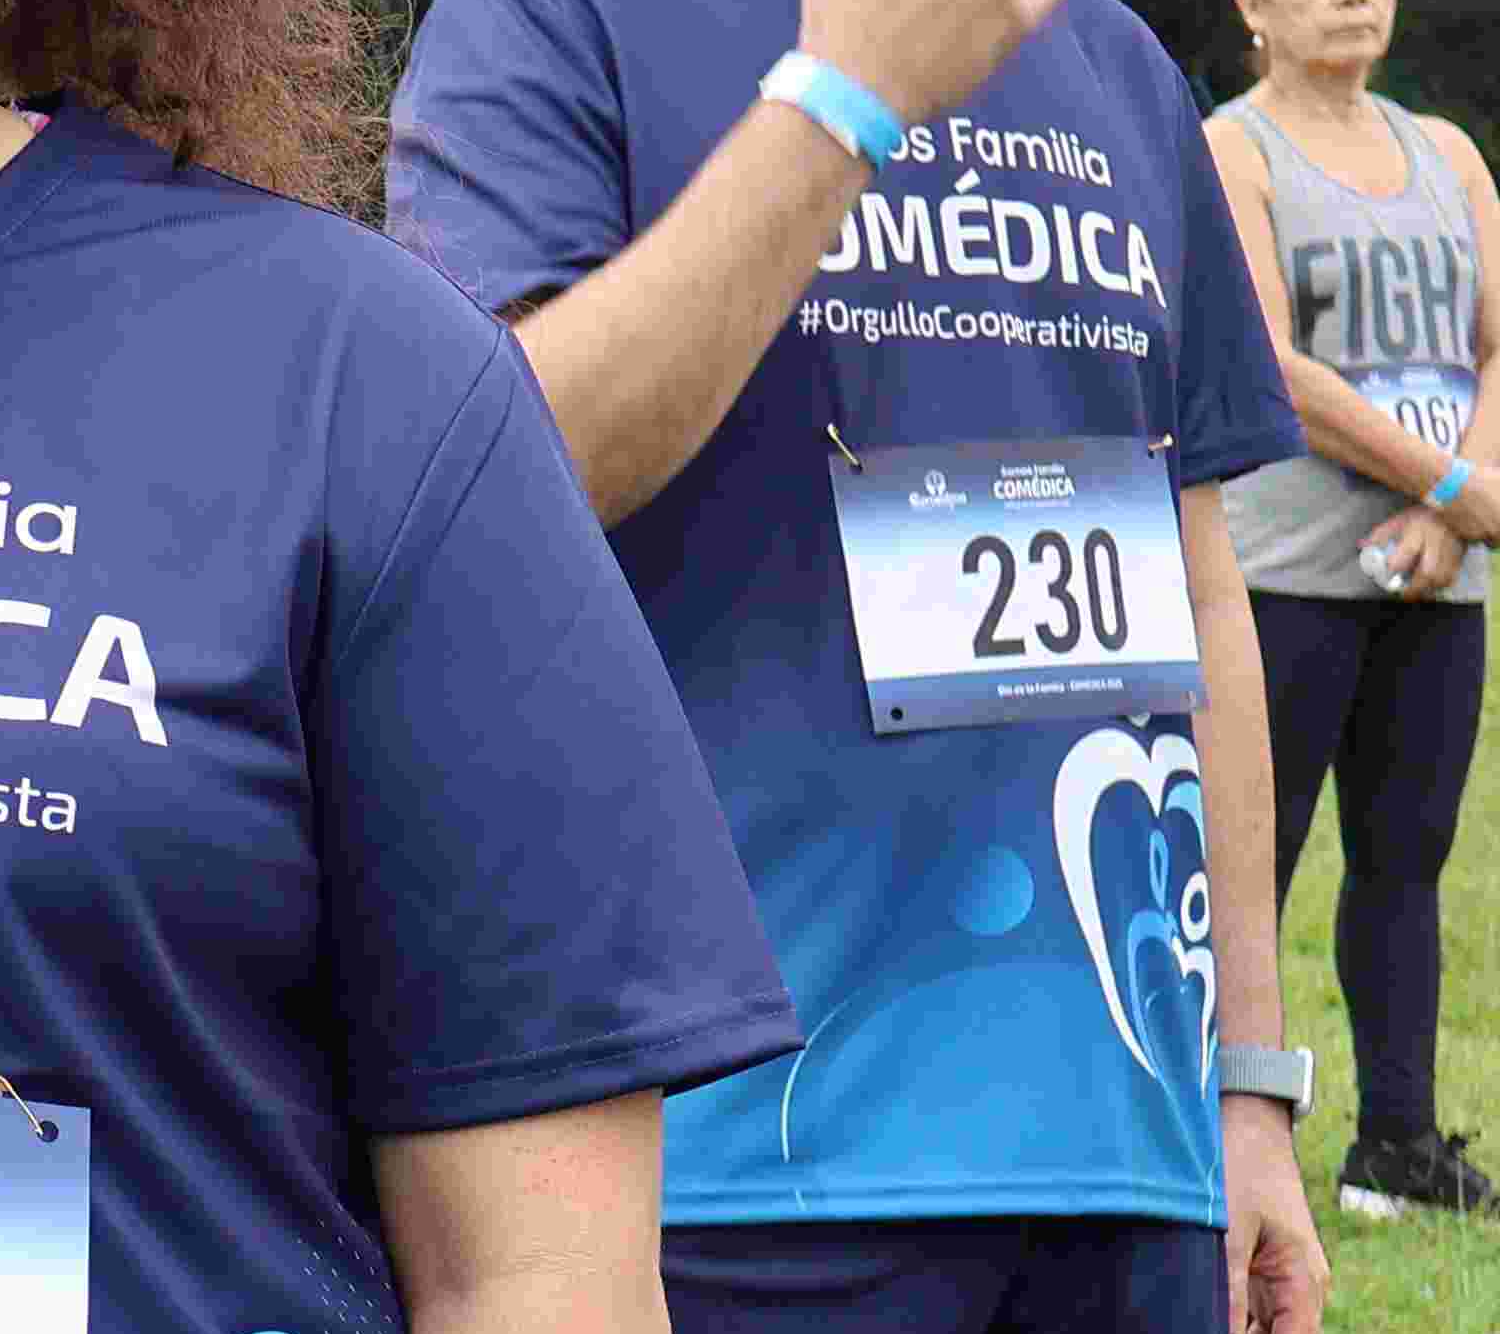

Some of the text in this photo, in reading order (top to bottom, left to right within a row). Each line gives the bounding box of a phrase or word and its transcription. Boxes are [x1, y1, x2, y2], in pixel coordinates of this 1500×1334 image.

[948, 116, 1114, 188] Familia
[816, 168, 1168, 308] MÉDICA
[799, 298, 1150, 360] #OrgulloCooperativista
[960, 527, 1129, 659] 230
